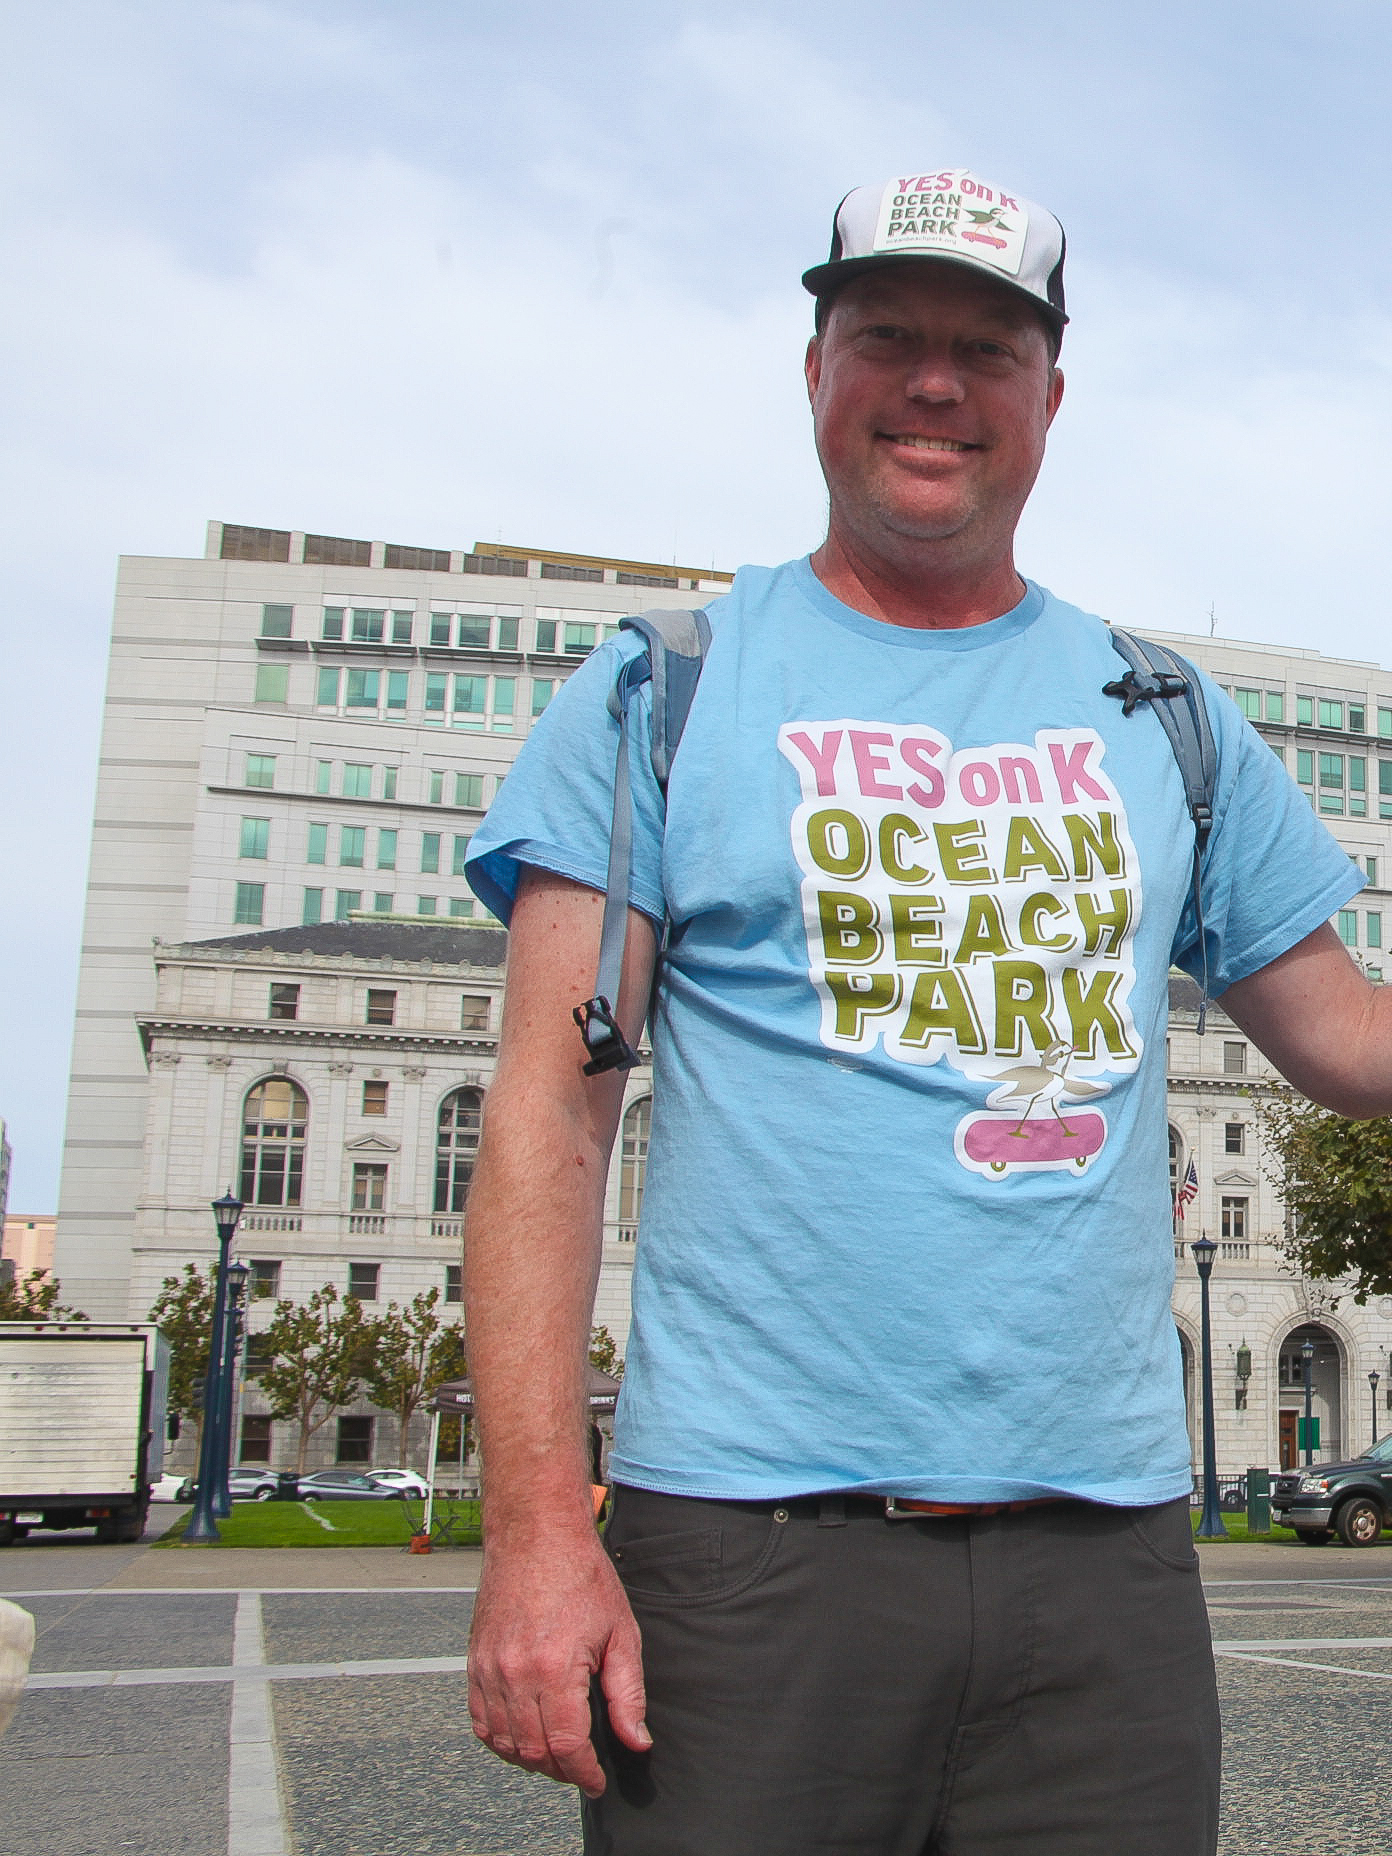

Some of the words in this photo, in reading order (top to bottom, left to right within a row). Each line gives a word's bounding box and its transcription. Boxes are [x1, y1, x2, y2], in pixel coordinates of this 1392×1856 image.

[891, 206, 961, 221] BEACH
[893, 193, 962, 207] OCEAN
[898, 172, 955, 193] YES
[960, 178, 993, 202] on
[999, 192, 1019, 212] K
[888, 219, 958, 237] PARK
[786, 729, 947, 809] YES
[959, 757, 1044, 807] on
[1048, 741, 1111, 805] K
[806, 809, 1128, 887] OCEAN
[817, 888, 1135, 967] BEACH
[824, 960, 1137, 1060] PARK
